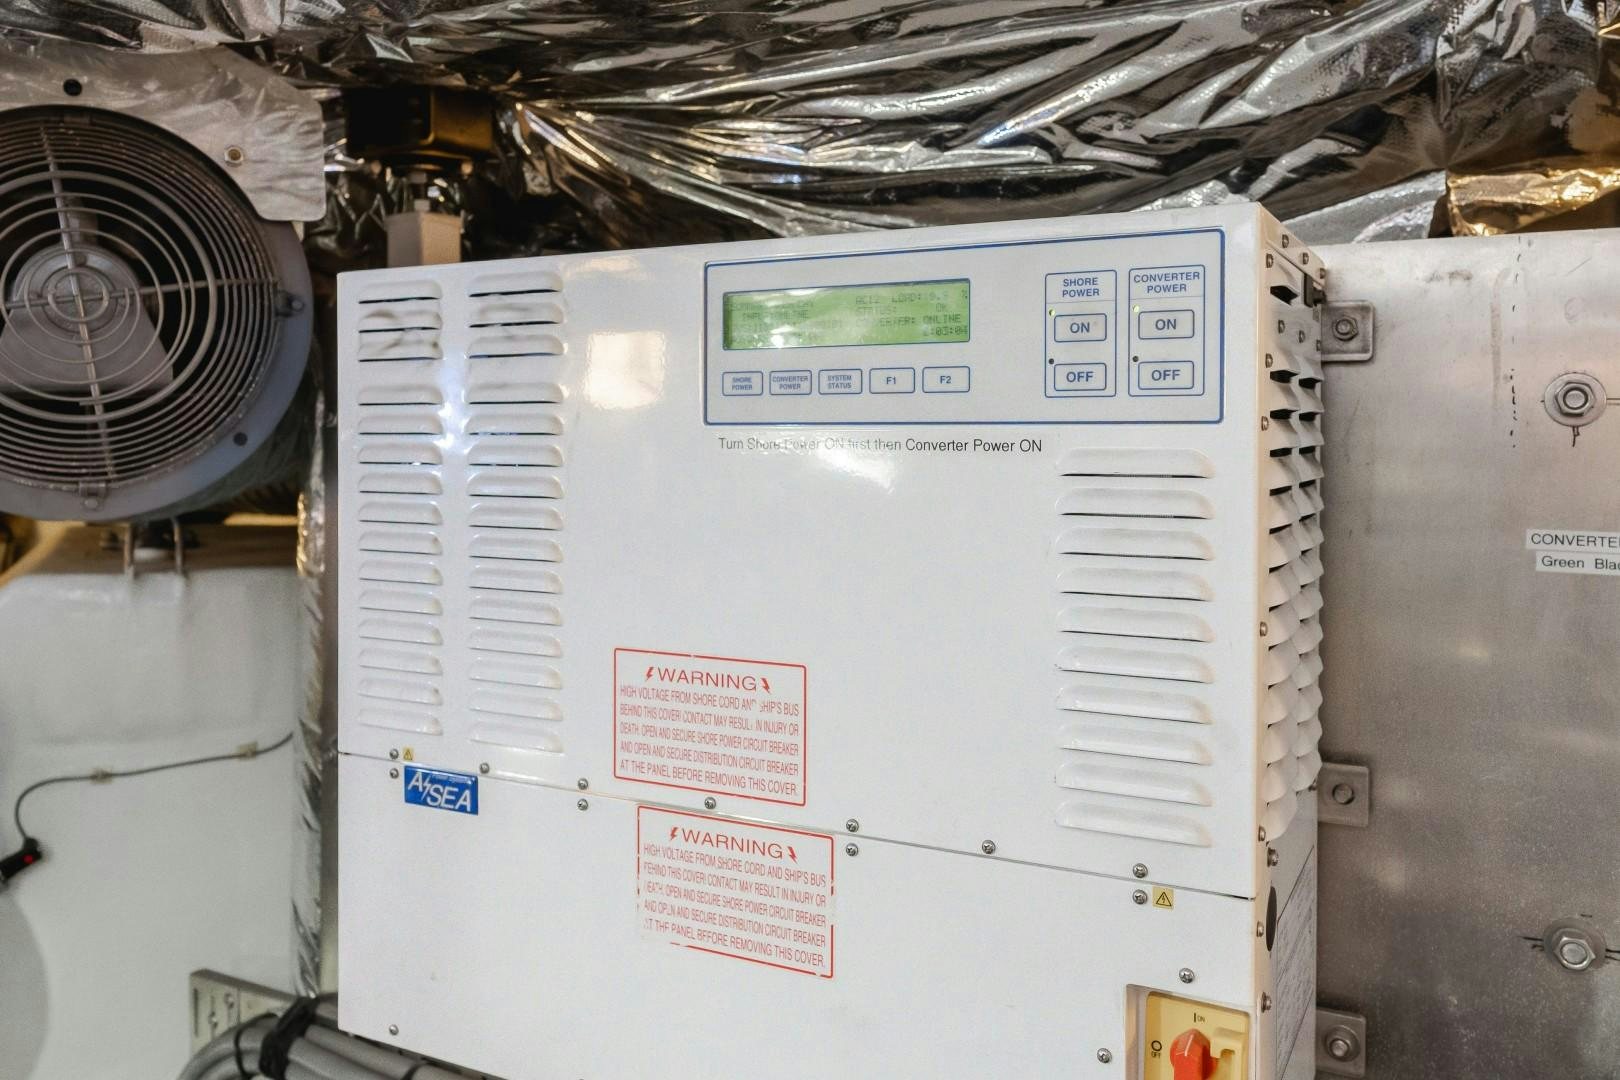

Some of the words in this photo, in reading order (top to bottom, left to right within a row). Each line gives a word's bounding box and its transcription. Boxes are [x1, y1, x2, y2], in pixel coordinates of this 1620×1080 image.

[1063, 277, 1099, 286] SHORE
[1134, 272, 1200, 284] CONVERTER
[1062, 288, 1100, 298] POWER
[1147, 284, 1187, 294] POWER
[922, 313, 961, 325] ONLINE
[1155, 318, 1177, 330] ON
[1070, 322, 1090, 334] ON
[772, 375, 809, 383] CONVERTER
[828, 374, 852, 382] SYSTEM
[886, 376, 897, 385] F1
[940, 376, 952, 384] F2
[1066, 371, 1094, 382] OFF
[1151, 369, 1181, 382] OFF
[828, 382, 852, 390] STATUS
[718, 437, 744, 450] Turn
[875, 438, 902, 451] then
[906, 438, 968, 452] Converter
[974, 438, 1015, 452] Power
[1019, 439, 1042, 452] ON
[1531, 533, 1620, 548] CONVERTE
[1542, 555, 1584, 568] Green
[657, 667, 756, 691] WARNING
[620, 685, 635, 697] HIGH
[637, 686, 668, 701] VOLTAGE
[671, 690, 691, 704] FROM
[693, 692, 716, 707] SHORE
[719, 695, 739, 709] CORD
[783, 702, 798, 716] BUS
[620, 703, 641, 717] BEHIND
[643, 706, 657, 719] THIS
[683, 710, 711, 725] CONTACT
[713, 714, 727, 727] MAY
[729, 715, 752, 730] RESUL
[755, 718, 761, 731] IN
[763, 719, 786, 734] INJURY
[788, 722, 798, 736] OR
[641, 724, 657, 738] OPEN
[658, 726, 670, 739] AND
[672, 728, 695, 742] SECURE
[697, 731, 717, 745] SHORE
[719, 733, 741, 748] POWER
[743, 736, 767, 752] CIRCUIT
[769, 740, 798, 756] BREAKER
[620, 740, 632, 753] AND
[634, 742, 651, 756] OPEN
[652, 744, 665, 757] AND
[666, 746, 691, 761] SECURE
[693, 749, 737, 767] DISTRIBUTION
[738, 755, 765, 771] CIRCUIT
[766, 759, 798, 776] BREAKER
[620, 759, 630, 771] AT
[631, 760, 646, 773] THE
[647, 762, 670, 777] PANEL
[672, 766, 701, 781] BEFORE
[705, 770, 745, 788] REMOVING
[747, 776, 765, 791] THIS
[681, 828, 782, 859] WARNING
[644, 843, 660, 857] HIGH
[662, 846, 693, 863] VOLTAGE
[695, 852, 716, 867] FROM
[717, 856, 741, 872] SHORE
[744, 860, 765, 876] CORD
[767, 864, 782, 879] AND
[784, 867, 808, 884] SHIP'S
[810, 872, 825, 887] BUS
[668, 866, 681, 881] THIS
[707, 873, 738, 891] CONTACT
[739, 879, 752, 894] MAY
[754, 881, 779, 899] RESULT
[781, 886, 788, 900] IN
[789, 888, 813, 905] INJURY
[815, 892, 826, 907] OR
[666, 885, 681, 900] OPEN
[696, 890, 720, 907] SECURE
[722, 895, 742, 912] SHORE
[744, 899, 767, 917] POWER
[769, 904, 794, 922] CIRCUIT
[795, 909, 826, 928] BREAKER
[676, 905, 689, 920] AND
[691, 908, 716, 925] SECURE
[718, 913, 763, 935] DISTRIBUTION
[765, 922, 791, 941] CIRCUIT
[793, 928, 825, 947] BREAKER
[671, 922, 694, 940] PANEL
[729, 934, 771, 956] REMOVING
[774, 943, 791, 960] THIS
